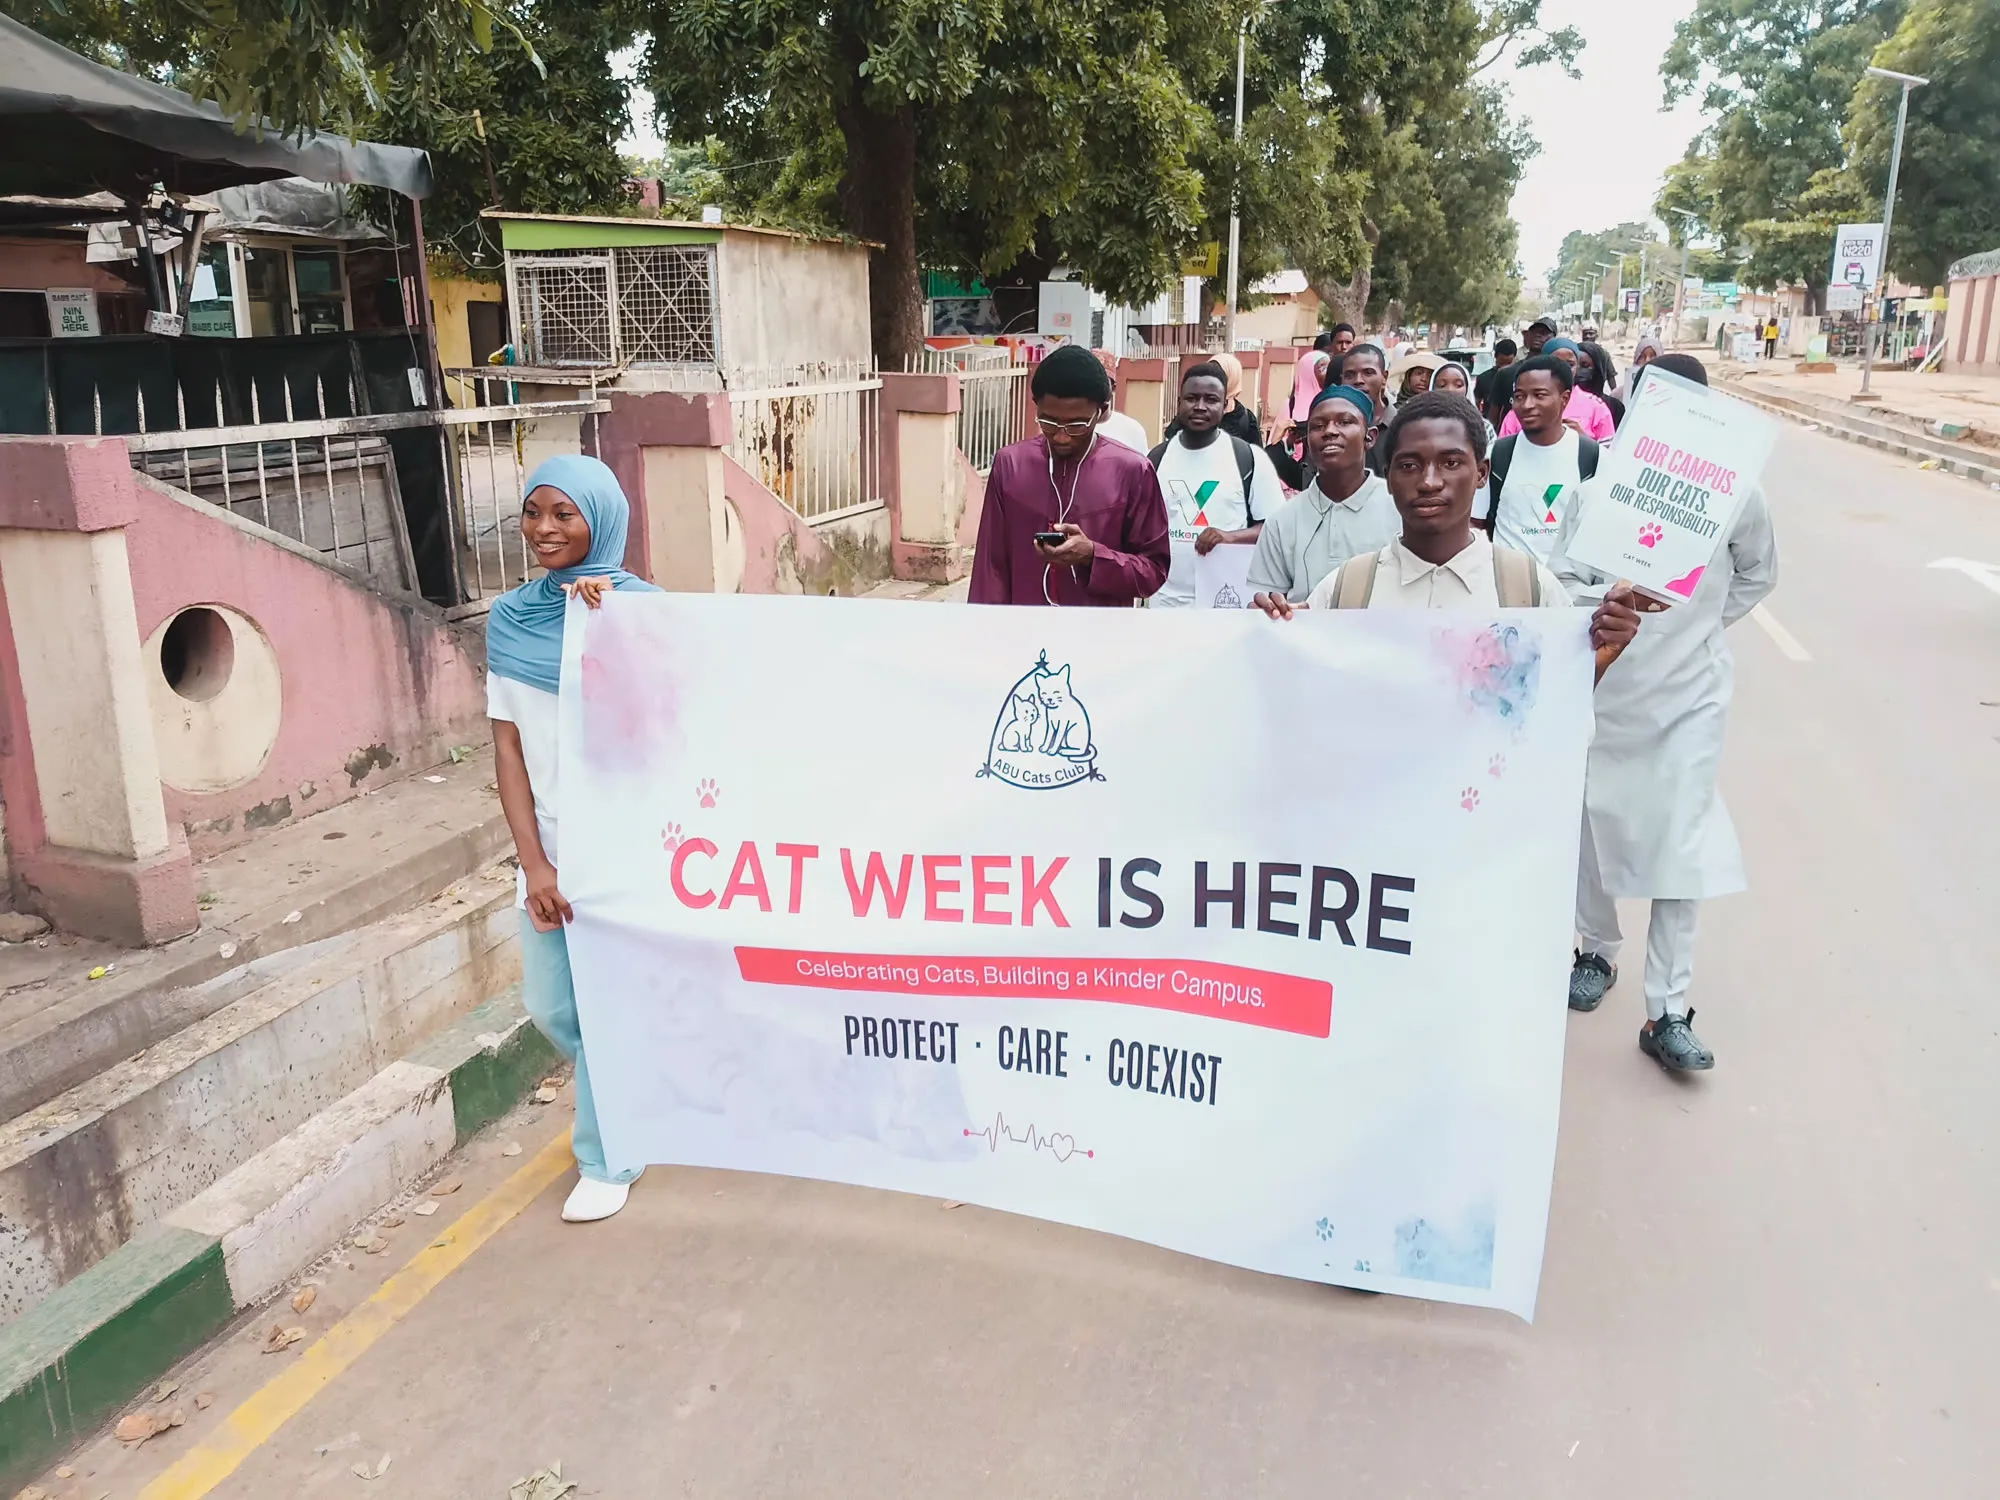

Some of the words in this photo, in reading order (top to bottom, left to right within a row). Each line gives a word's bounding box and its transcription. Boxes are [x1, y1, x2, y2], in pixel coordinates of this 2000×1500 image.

[61, 323, 89, 332] HERE
[63, 307, 82, 315] NIN
[1634, 436, 1669, 468] OUR
[1668, 449, 1736, 496] CAMPUS.
[1609, 483, 1635, 505] OUR
[1633, 493, 1720, 539] RESPONSIBILITY
[1636, 467, 1671, 498] OUR
[1669, 480, 1710, 515] CATS.
[1623, 553, 1635, 561] CAT
[1635, 557, 1652, 567] WEEK
[993, 759, 1020, 779] ABU
[1022, 770, 1051, 784] Cats
[1054, 764, 1085, 781] Club
[670, 837, 819, 914] CAT
[840, 847, 1071, 927] WEEK
[1098, 857, 1165, 929] IS
[1194, 861, 1415, 955] HERE
[796, 959, 919, 986] Celebrating
[925, 964, 980, 986] Cats,
[983, 966, 1069, 990] Building
[1076, 973, 1088, 986] a
[1094, 968, 1166, 990] Kinder
[1171, 970, 1266, 1008] Campus.
[844, 1015, 959, 1064] PROTECT
[998, 1025, 1068, 1078] CARE
[1108, 1038, 1222, 1105] COEXIST
